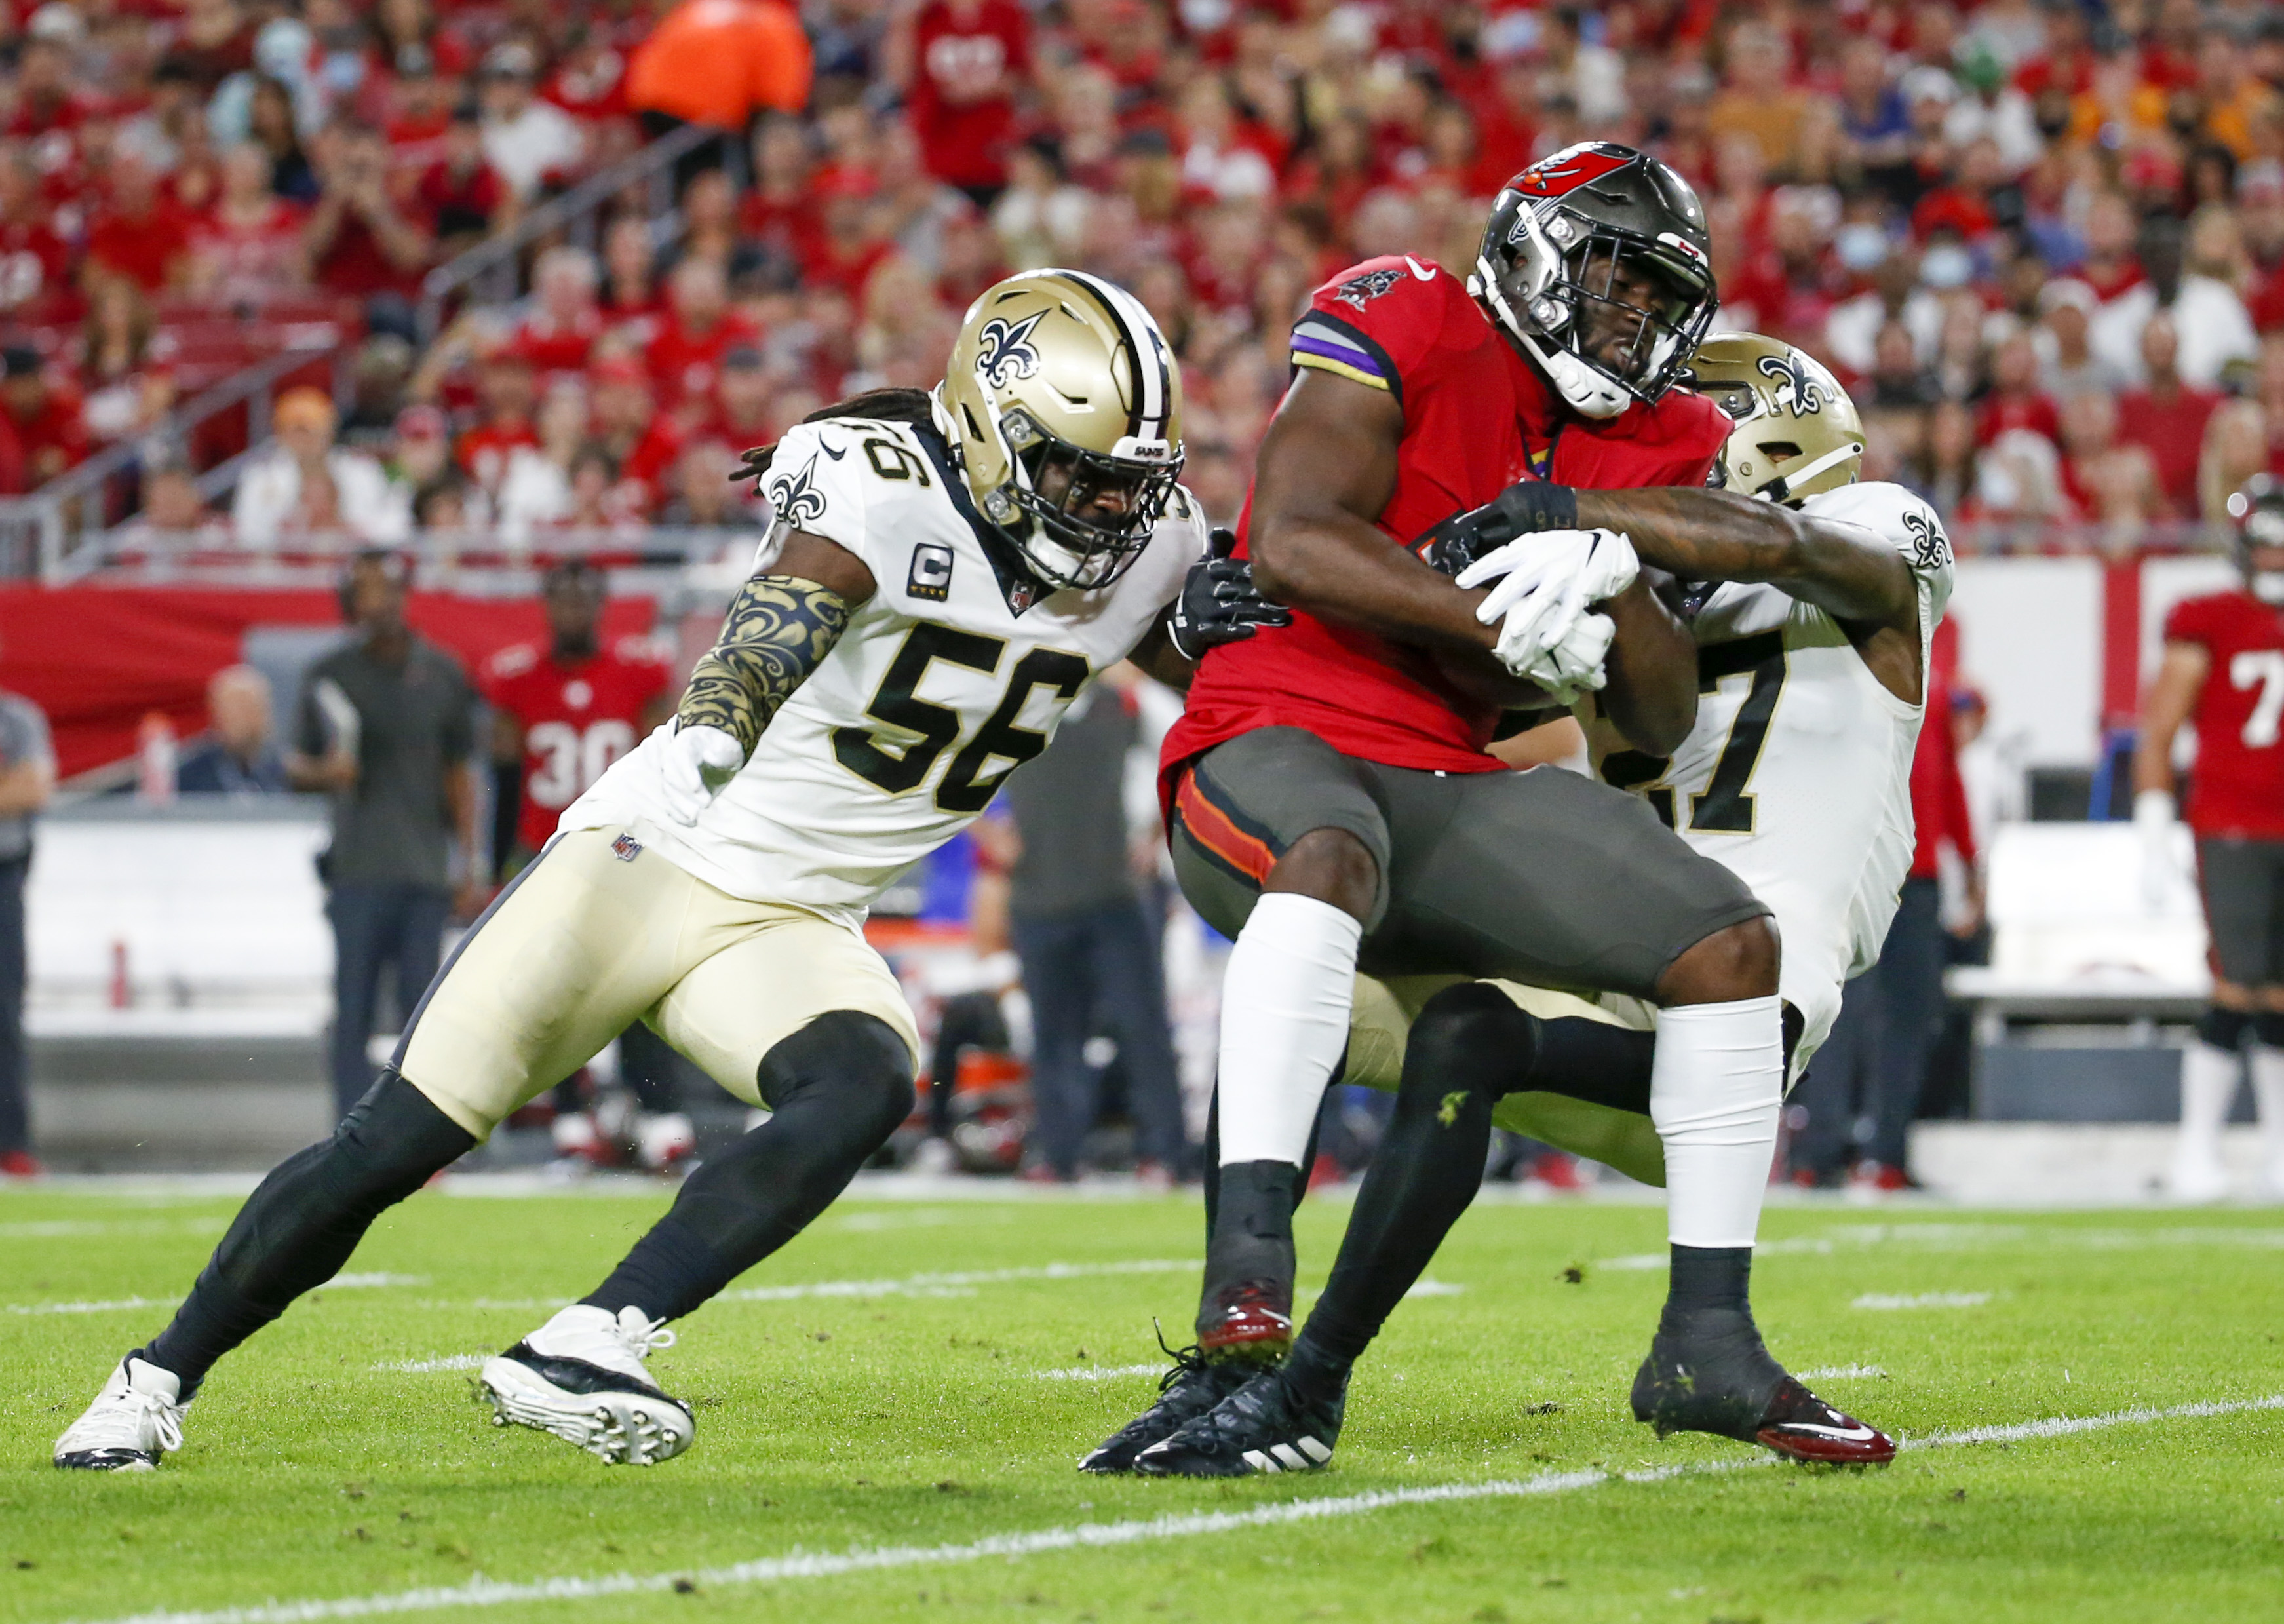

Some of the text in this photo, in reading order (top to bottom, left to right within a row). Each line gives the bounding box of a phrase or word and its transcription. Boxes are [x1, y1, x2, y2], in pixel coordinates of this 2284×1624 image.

[913, 547, 950, 587] C
[828, 620, 1092, 815] 56
[2230, 648, 2284, 748] 7
